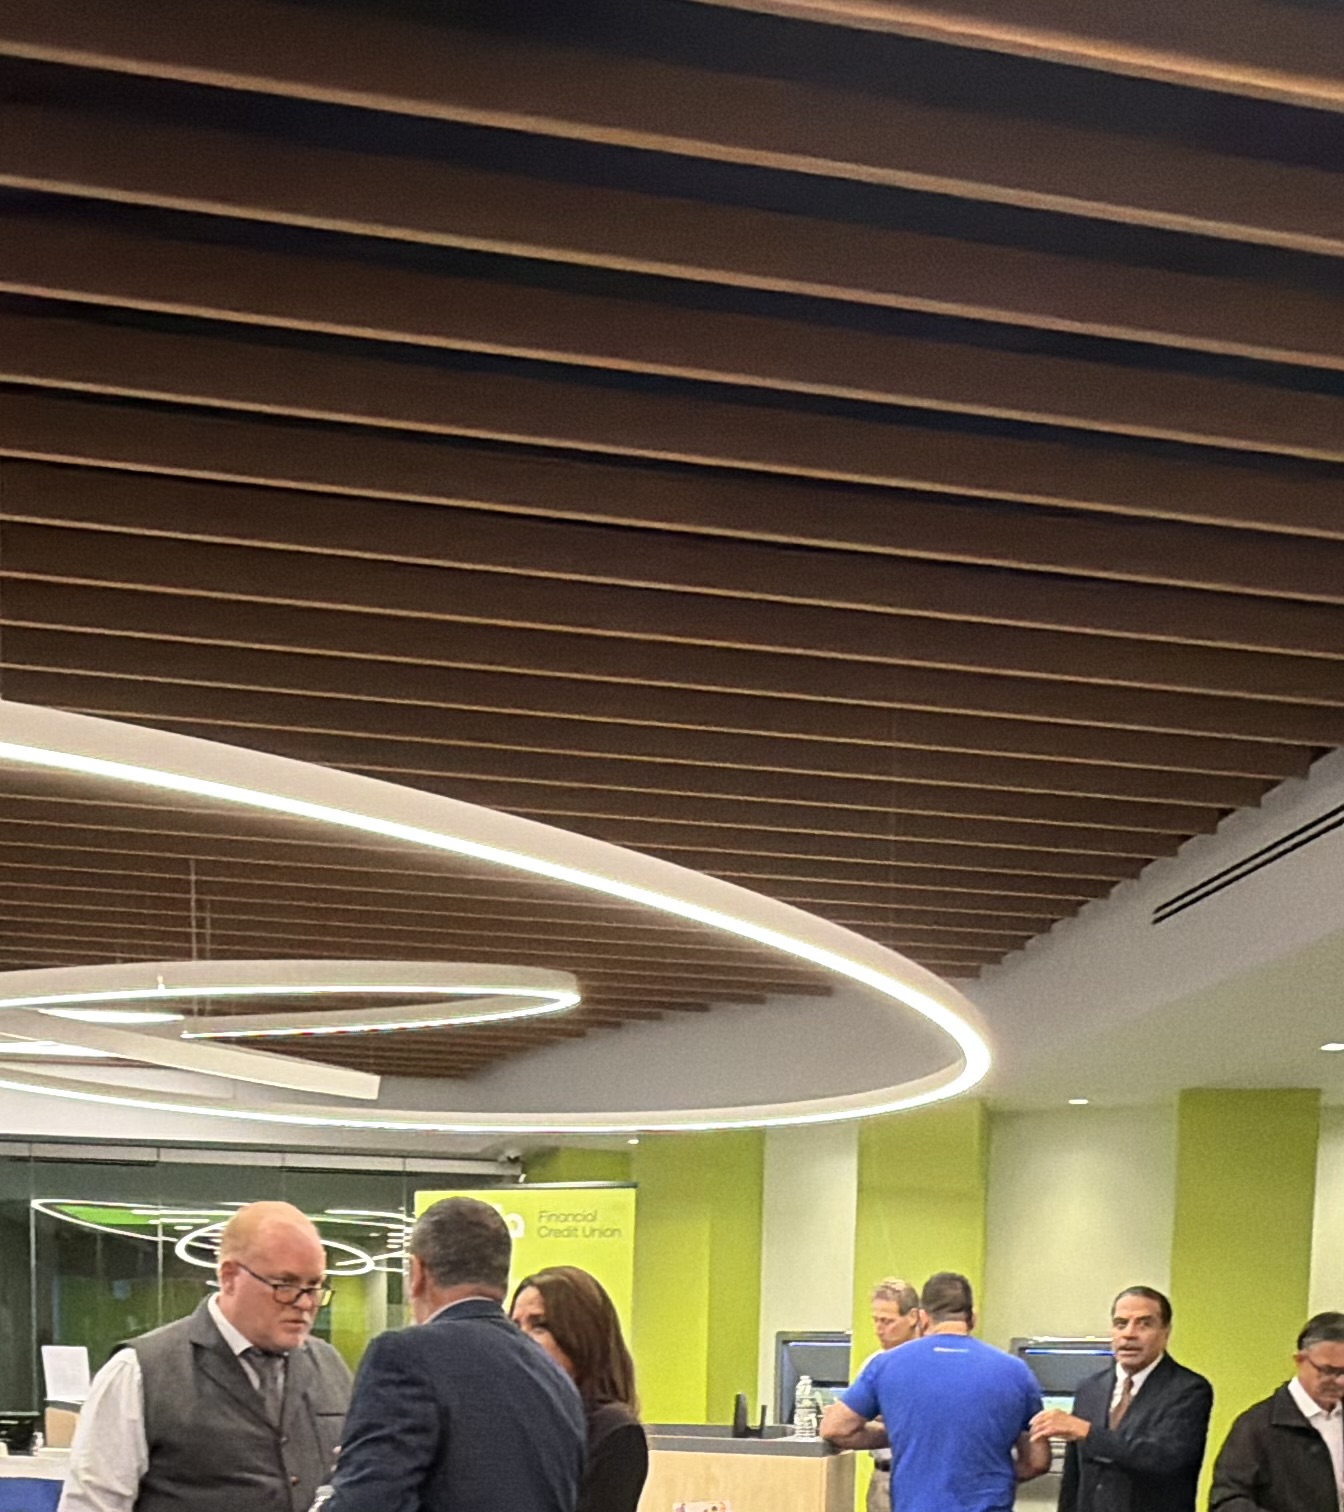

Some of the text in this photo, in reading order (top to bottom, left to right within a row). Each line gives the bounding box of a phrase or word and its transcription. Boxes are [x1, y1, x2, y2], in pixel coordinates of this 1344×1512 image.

[538, 1209, 598, 1222] Financial
[537, 1225, 622, 1238] Credit Union
